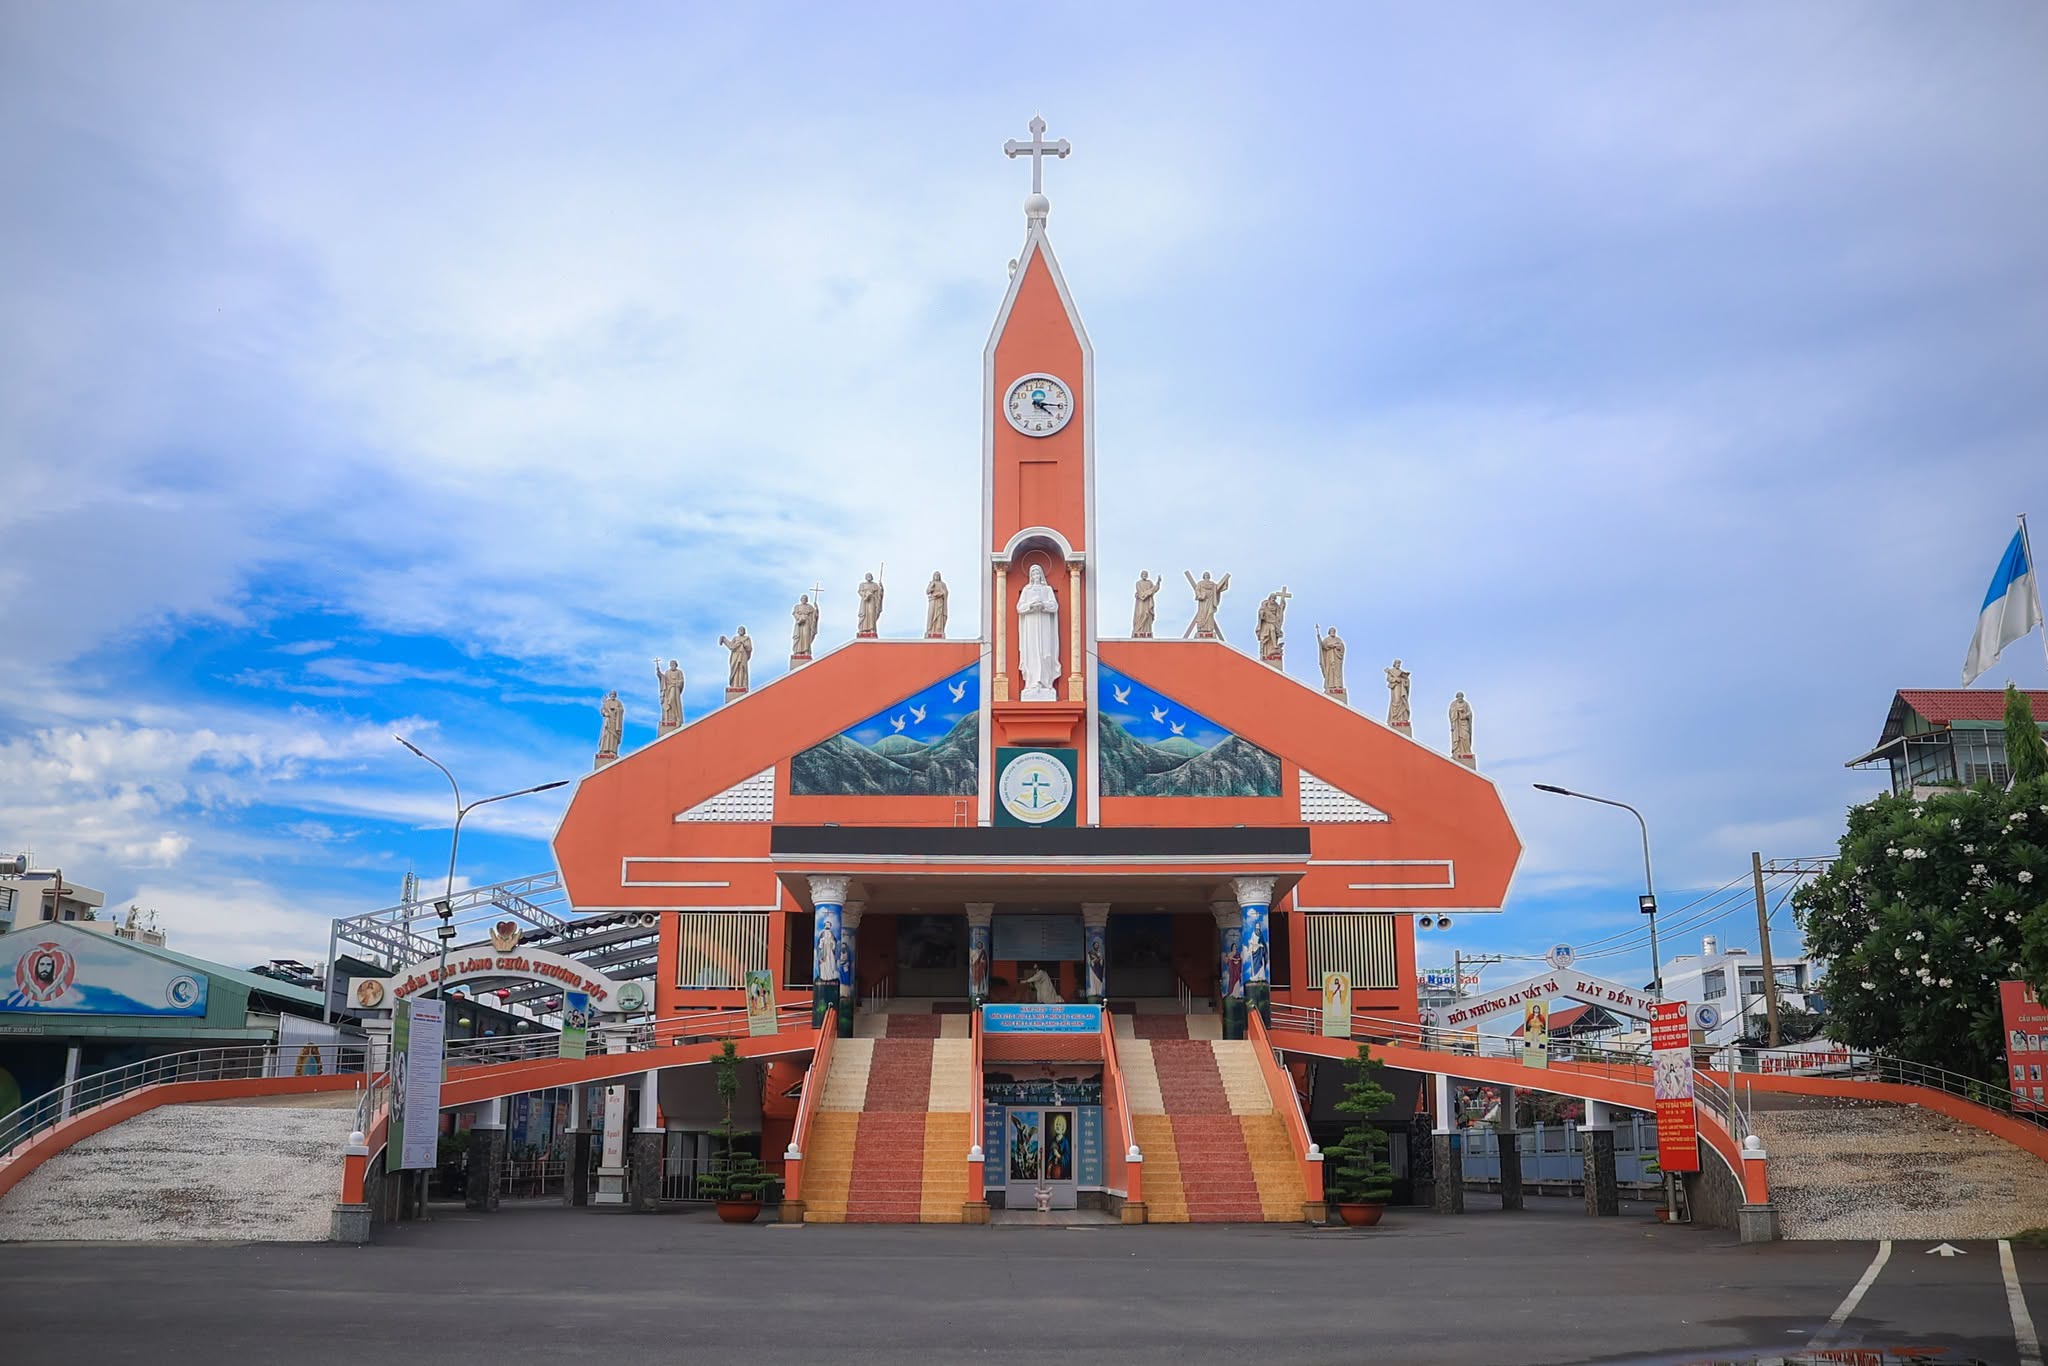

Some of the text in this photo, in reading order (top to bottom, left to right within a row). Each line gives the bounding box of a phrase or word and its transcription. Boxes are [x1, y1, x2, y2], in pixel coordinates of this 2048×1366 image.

[394, 973, 428, 998] ĐIỂM
[459, 957, 493, 974] LÒNG
[496, 956, 530, 972] CHÚA
[533, 961, 582, 987] THƯƠNG
[581, 980, 608, 1002] XÓT
[1428, 974, 1455, 986] Ngôi
[1576, 981, 1603, 996] HÃY
[1607, 989, 1633, 1006] ĐẾN
[1468, 998, 1507, 1018] NHỮNG
[1508, 993, 1521, 1006] AI
[1522, 983, 1542, 999] VẤT
[1543, 978, 1559, 993] VẢ
